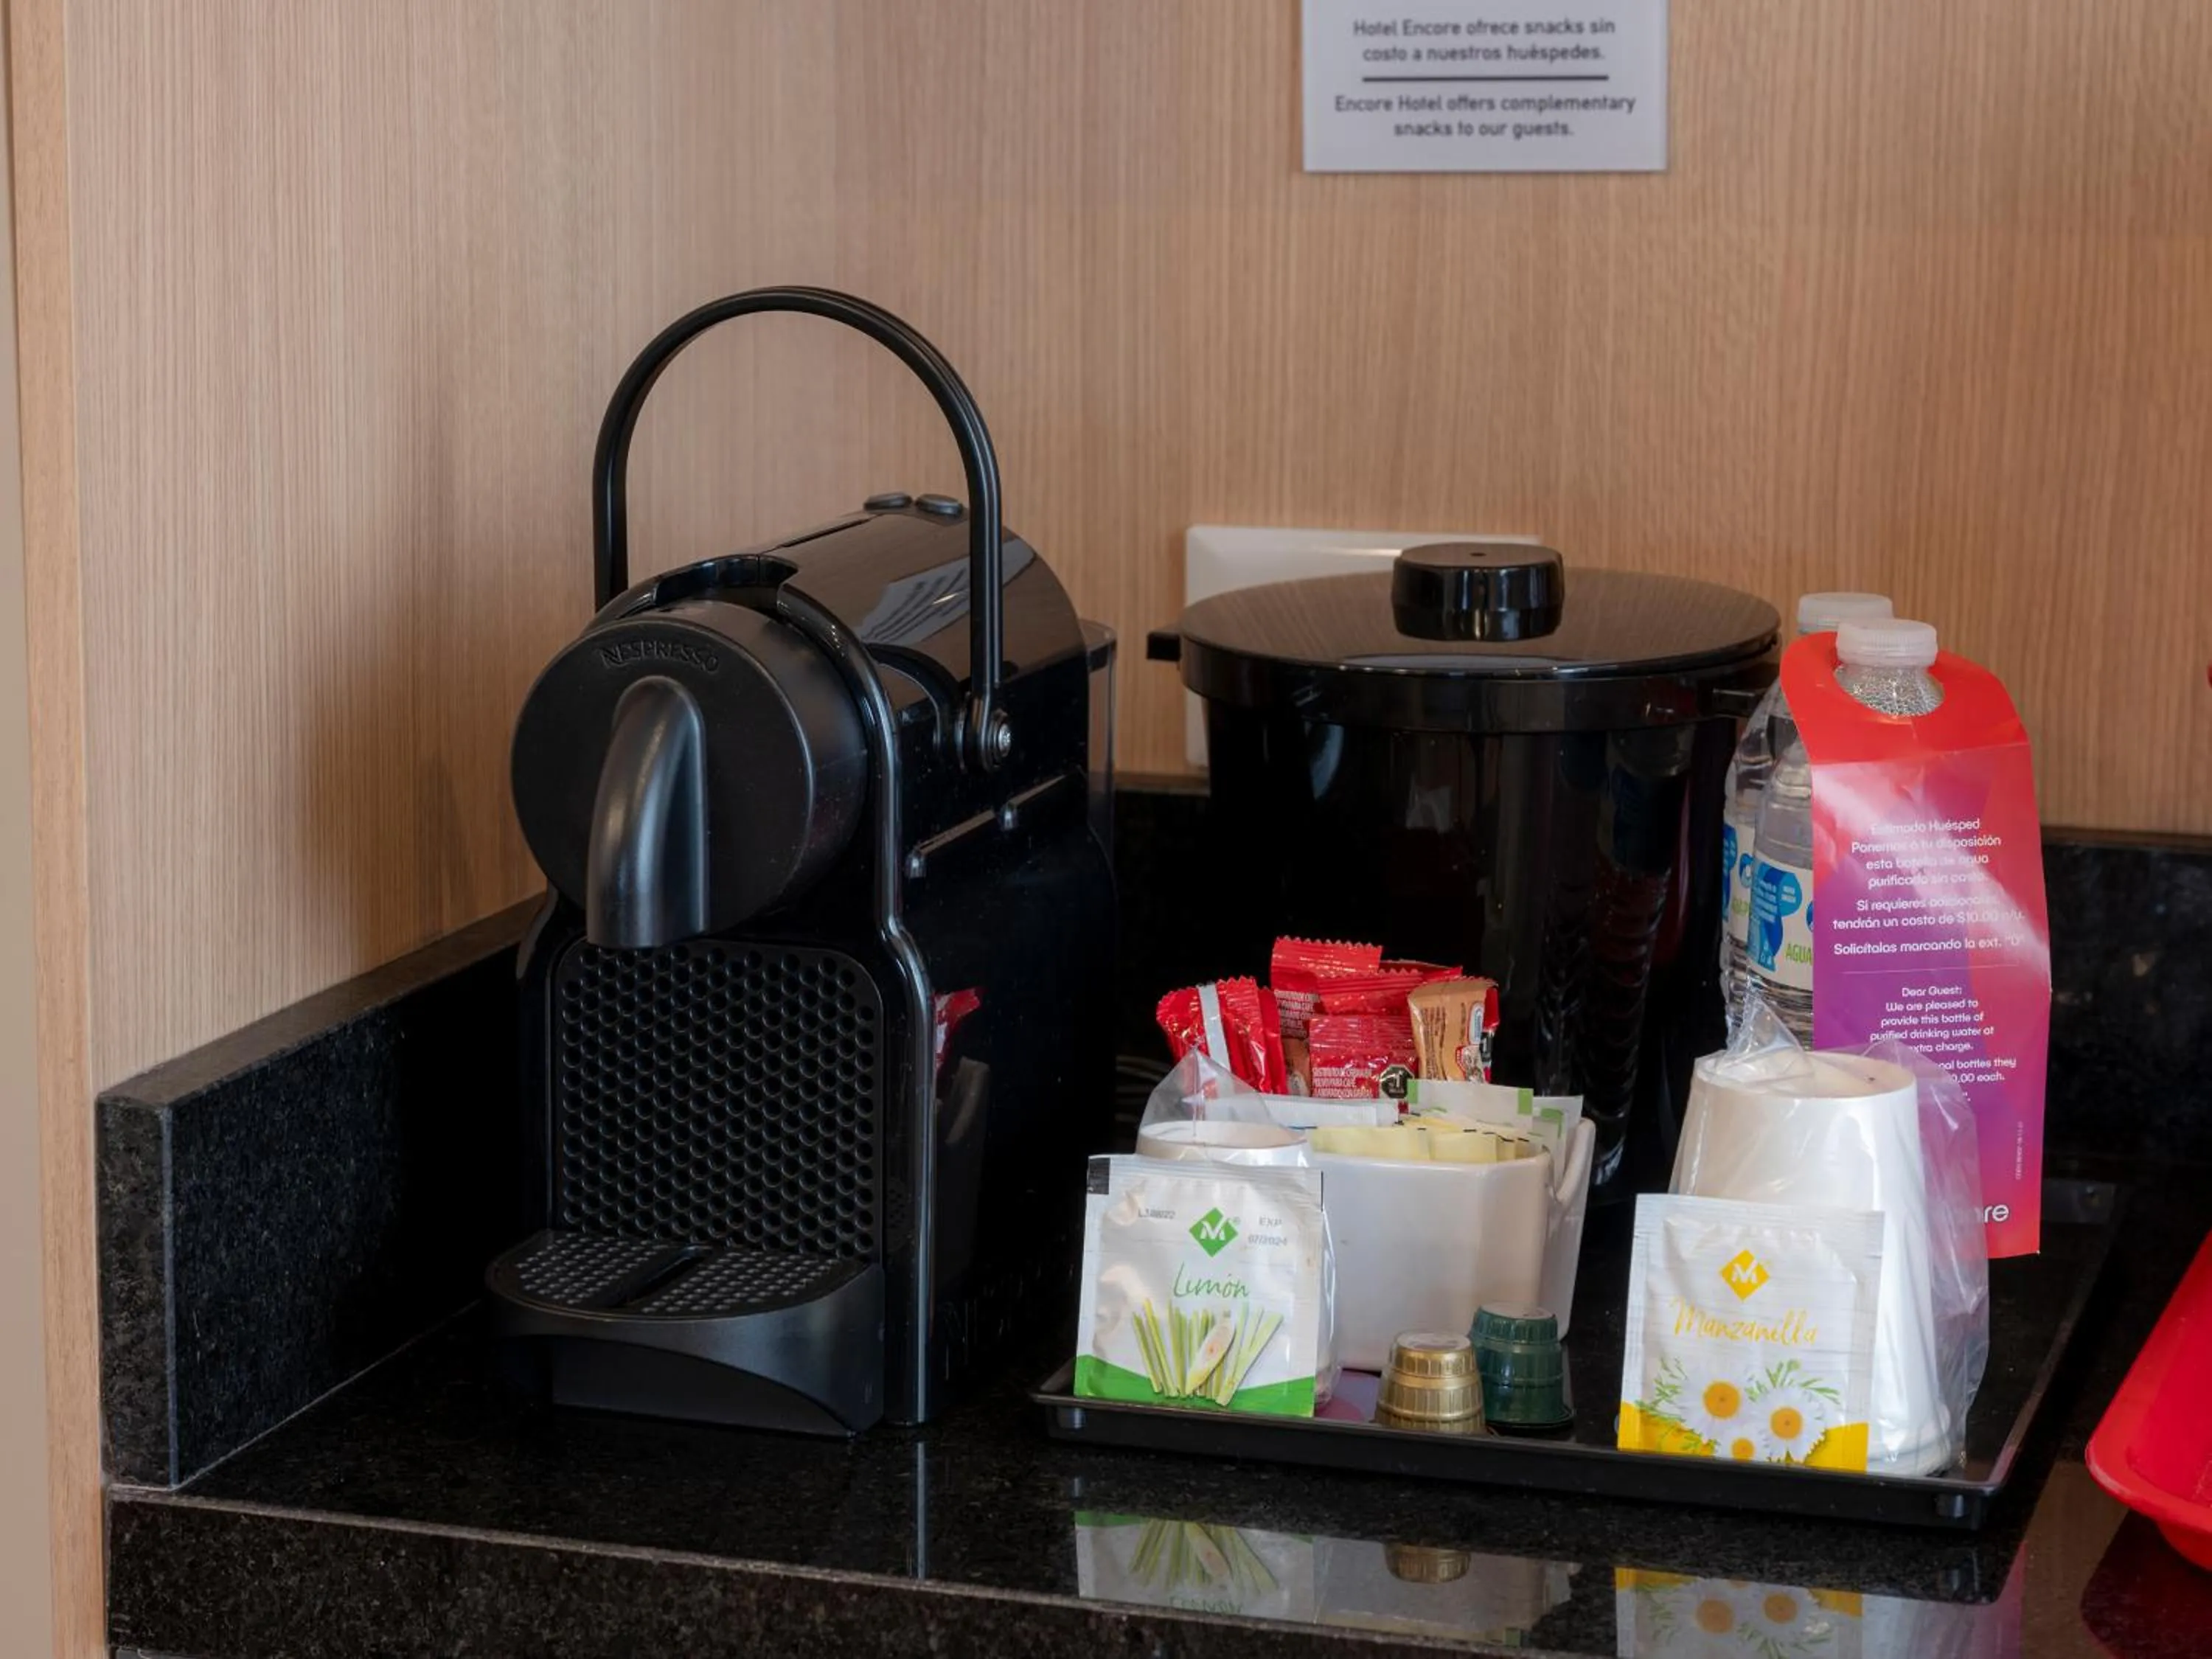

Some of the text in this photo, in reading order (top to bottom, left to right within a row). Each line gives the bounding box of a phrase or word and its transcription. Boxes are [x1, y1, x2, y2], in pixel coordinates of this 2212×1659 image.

[1353, 18, 1615, 36] Hotel Encore ofrece snacks sin
[1363, 44, 1604, 64] costo a nuestros huéspedes.
[1335, 95, 1635, 114] Encore Hotel offers complementary
[1394, 120, 1574, 139] snacks to our guests.
[599, 639, 720, 674] NESPRESSO
[1921, 839, 1934, 849] tu
[1865, 858, 1893, 869] esta
[1857, 899, 1868, 911] Si
[1871, 897, 1926, 913] requieres
[1833, 915, 1880, 929] tendrán
[1883, 917, 1899, 927] un
[1902, 914, 1935, 926] costo
[1938, 912, 1954, 925] de
[1900, 938, 1961, 953] marcando
[1964, 937, 1975, 949] la
[1978, 937, 2002, 949] ext.
[1902, 987, 1926, 997] Dear
[1885, 998, 1978, 1012] We are pleased to
[1881, 1010, 1984, 1028] provide this bottle of
[1870, 1026, 1994, 1042] purified drinking water at
[1935, 1041, 1974, 1053] charge.
[1956, 1059, 1992, 1069] bottles
[1994, 1057, 2017, 1068] they
[1977, 1071, 2005, 1082] each.
[1173, 1261, 1250, 1298] Limón
[1669, 1295, 1818, 1346] Manzanilla
